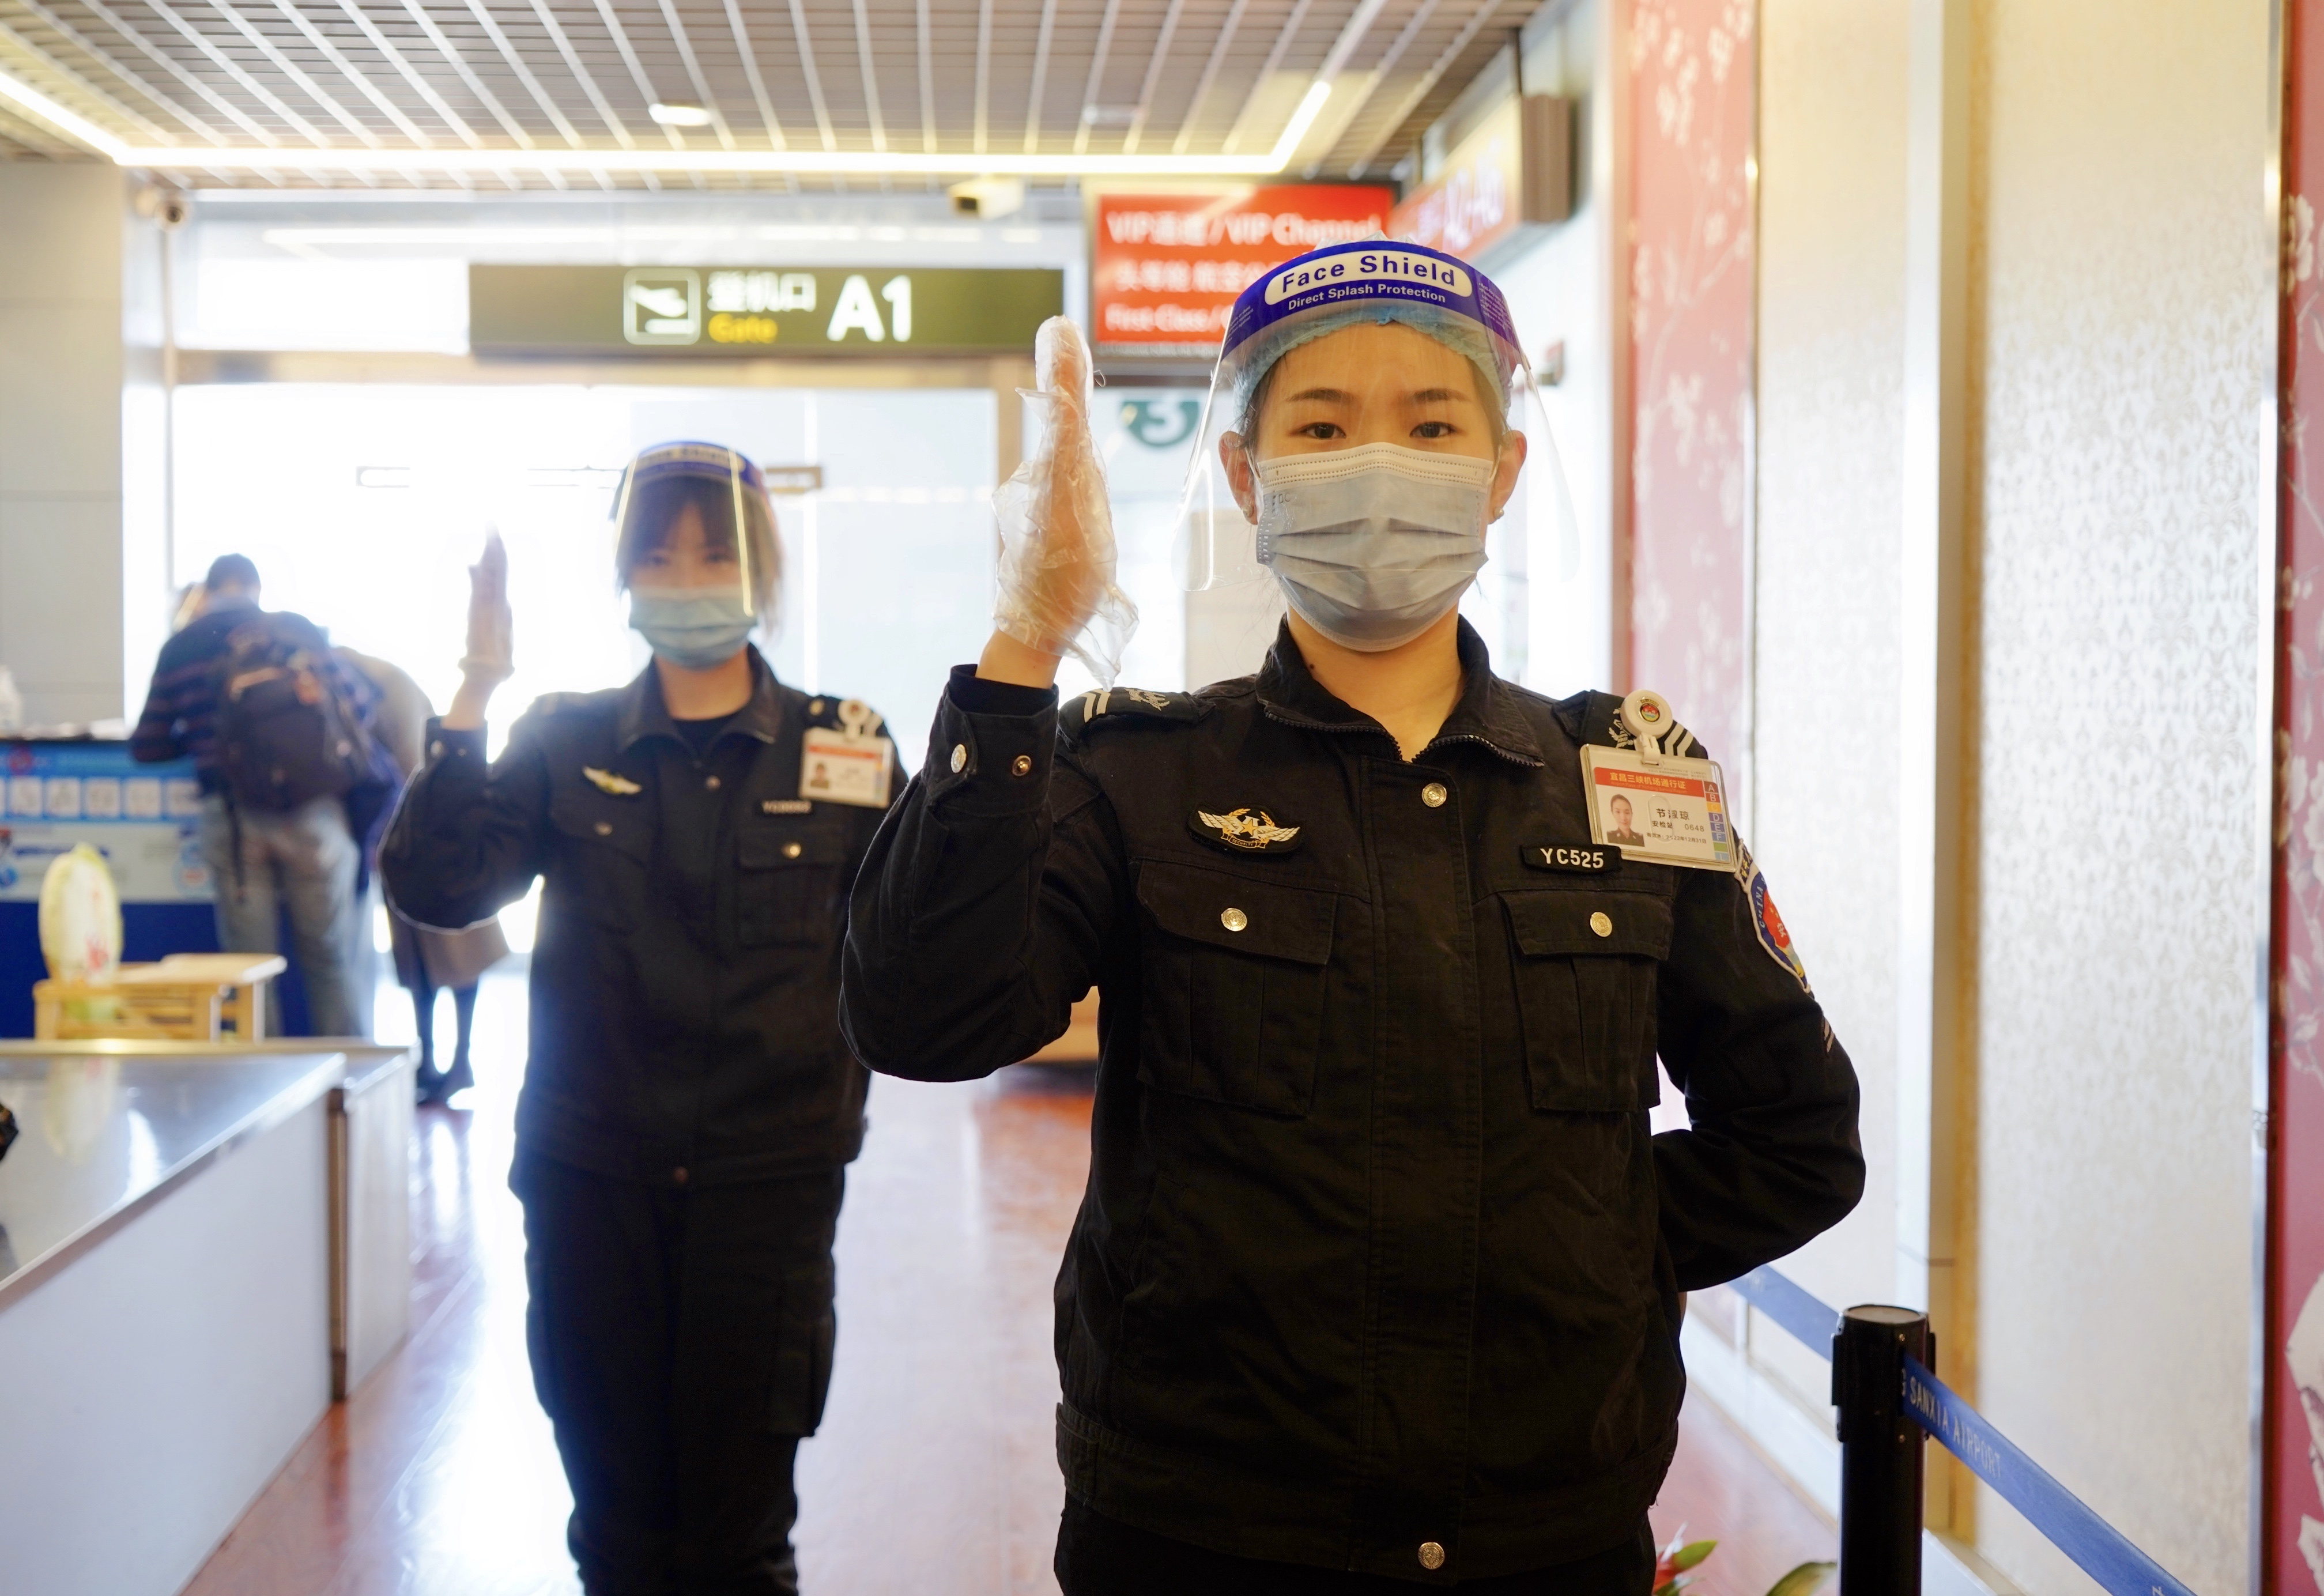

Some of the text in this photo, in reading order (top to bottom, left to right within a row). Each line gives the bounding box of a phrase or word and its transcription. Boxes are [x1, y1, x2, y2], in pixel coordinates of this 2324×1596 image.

[1282, 263, 1345, 293] Face
[1360, 255, 1455, 286] Shield
[827, 274, 912, 342] A1
[1288, 284, 1446, 311] Direct Splash Protection
[708, 312, 778, 344] Gate
[1610, 772, 1686, 789] 宜昌三峡机场通行证
[1710, 794, 1716, 802] B
[1713, 813, 1720, 821] D
[1684, 824, 1704, 832] 0648
[1232, 838, 1254, 847] SECURITY
[1540, 848, 1604, 869] YC525
[1910, 1375, 1949, 1435] SANXIA
[1953, 1416, 2001, 1479] AIRPORT
